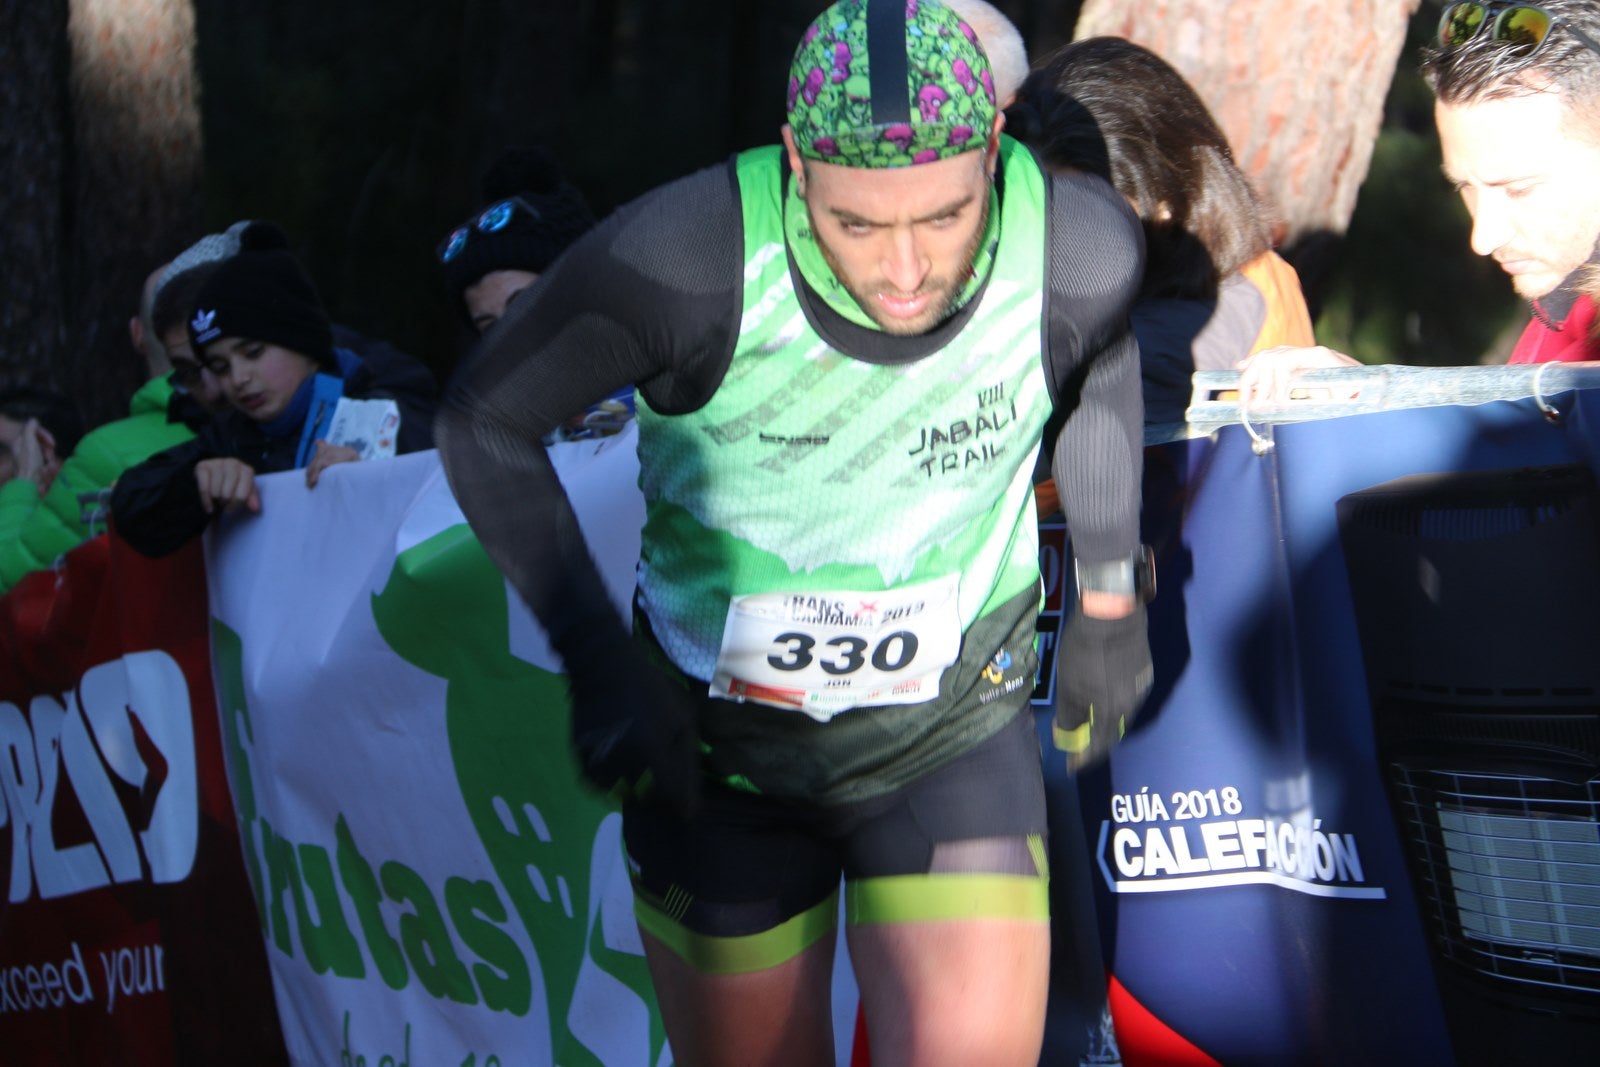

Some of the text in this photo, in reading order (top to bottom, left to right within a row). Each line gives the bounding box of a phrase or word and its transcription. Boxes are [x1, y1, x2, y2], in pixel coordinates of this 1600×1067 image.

[977, 381, 1004, 409] VIII
[919, 443, 1005, 478] TRAIL
[766, 631, 919, 675] 330
[1111, 786, 1243, 823] GUÍA 2018
